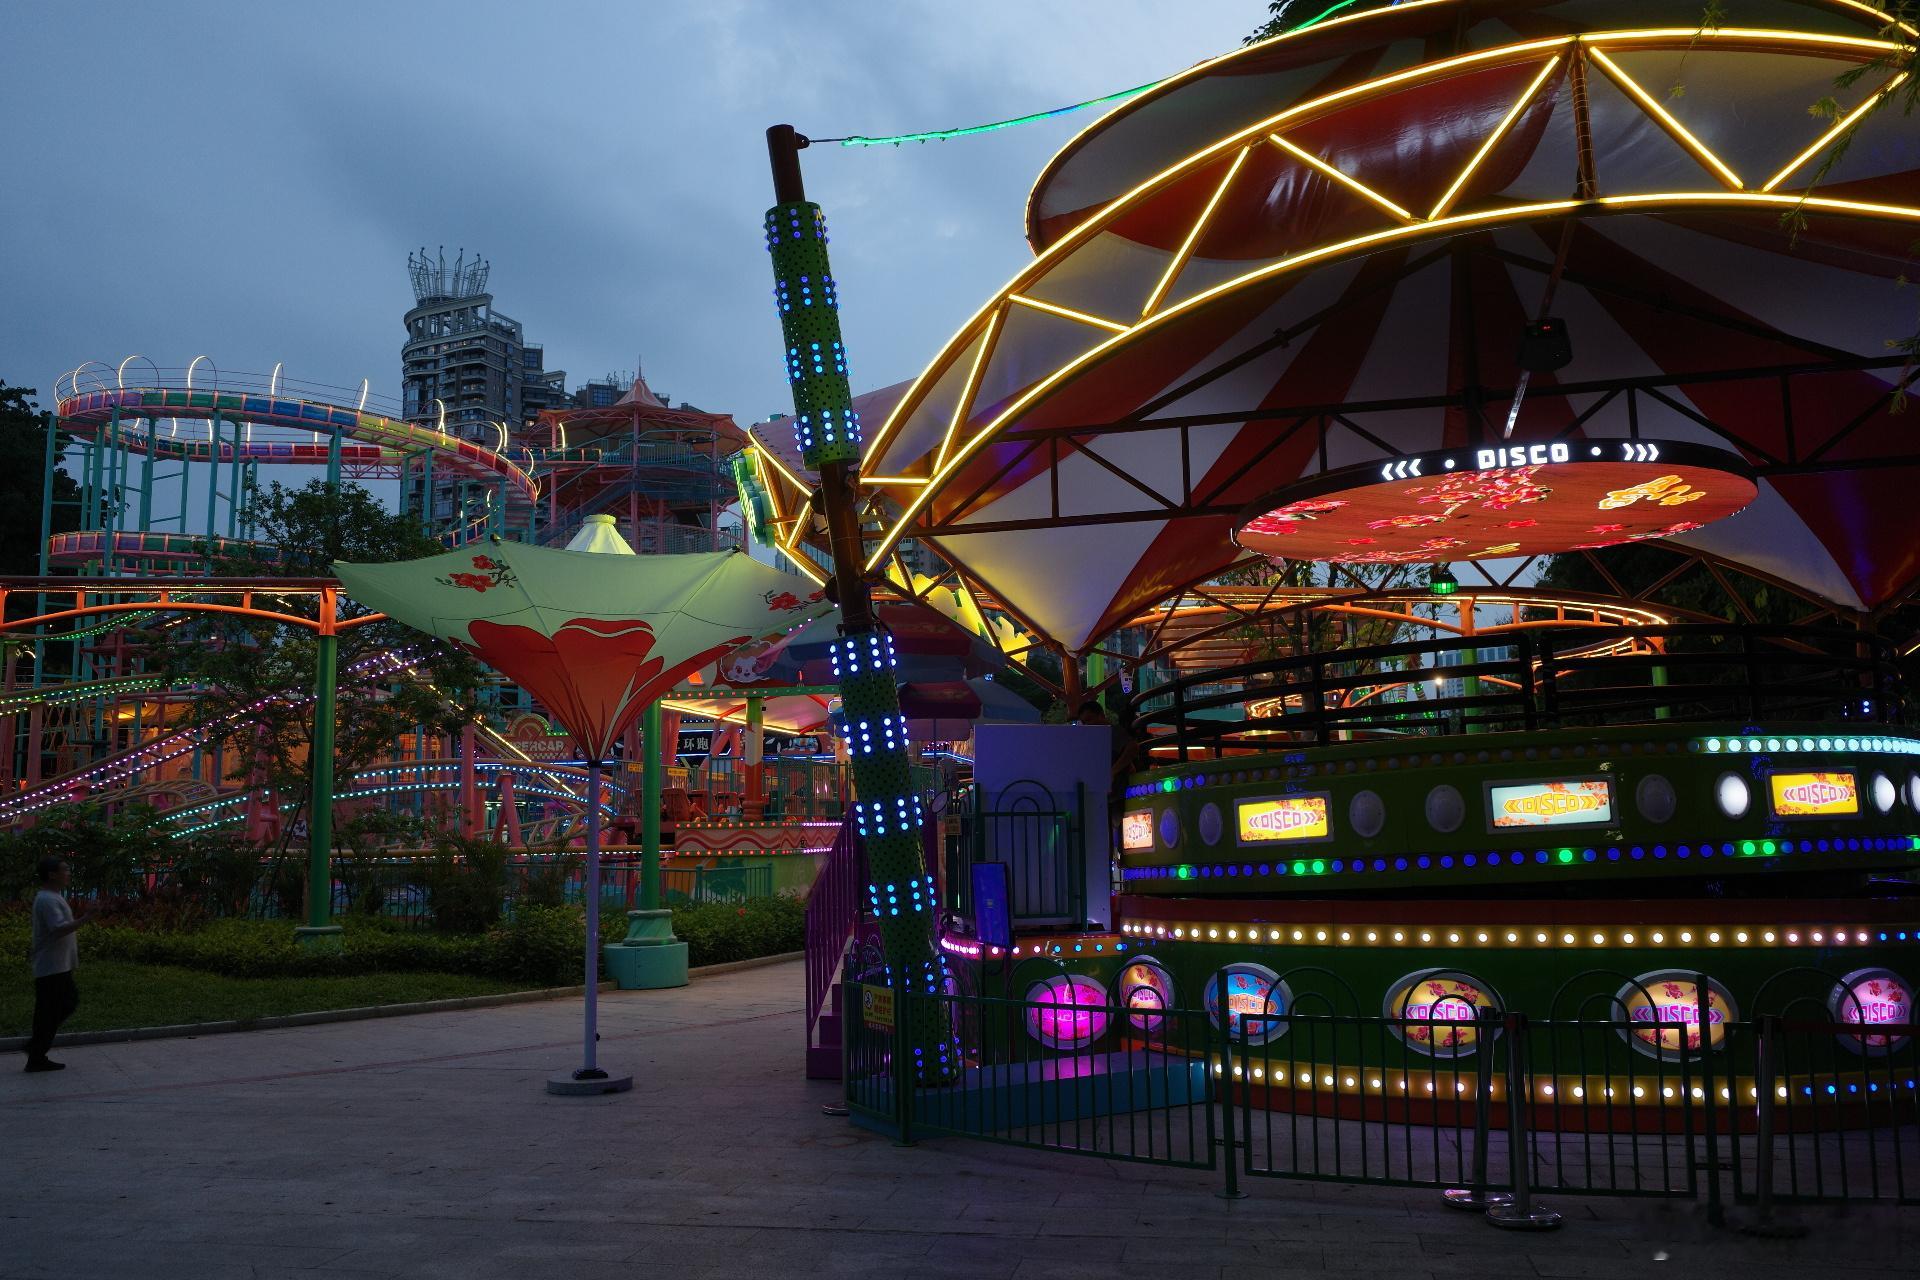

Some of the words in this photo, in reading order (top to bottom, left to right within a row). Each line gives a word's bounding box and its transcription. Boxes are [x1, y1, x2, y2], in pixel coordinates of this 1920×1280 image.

[1477, 443, 1569, 470] DISCO
[1522, 793, 1579, 815] DISCO
[1798, 784, 1836, 804] DISCO
[1261, 811, 1301, 830] DISCO
[1418, 1003, 1468, 1021] DSCO
